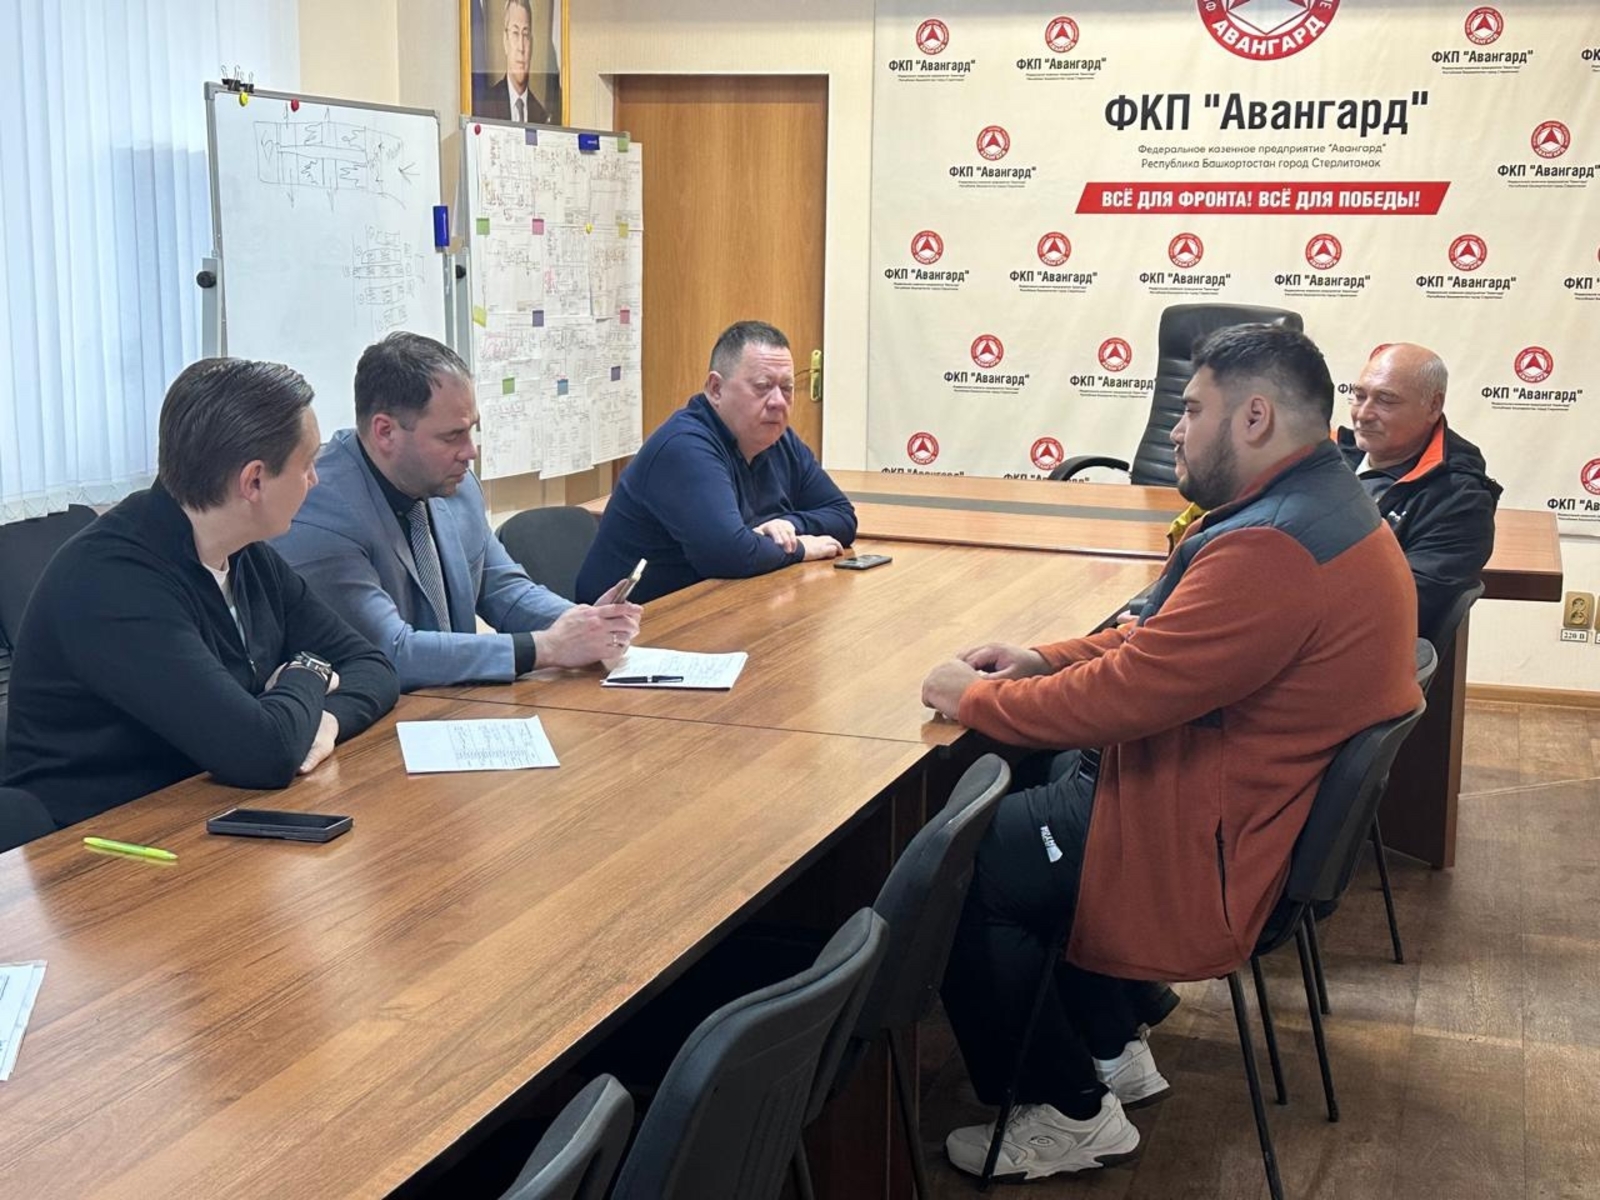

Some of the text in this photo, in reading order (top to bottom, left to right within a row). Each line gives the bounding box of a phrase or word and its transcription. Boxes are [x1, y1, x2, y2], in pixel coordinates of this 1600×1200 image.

[1201, 16, 1326, 55] АВАНГАРД
[1016, 57, 1106, 71] ФКП "Авангард"
[1431, 50, 1533, 65] ФКП "Авангард"
[889, 60, 975, 73] ФКП "Авангард"
[1105, 91, 1429, 137] ФКП "Авангард"
[1138, 145, 1206, 155] Федеральное
[1258, 145, 1326, 155] предприятие
[1141, 157, 1381, 170] Республика Башкортостан город Стерлитамак
[1497, 164, 1526, 177] ФКП
[949, 166, 1036, 180] ФКП "Авангард"
[1102, 188, 1420, 210] ВСЁ ДЛЯ ФРОНТА! ВСЁ ДЛЯ ПОБЕДЫ!
[884, 268, 969, 282] ФКП "Авангард"
[1010, 270, 1098, 285] ФКП "Авангард"
[1139, 272, 1231, 287] ФКП "Авангард"
[1274, 274, 1370, 289] ФКП "Авангард"
[1416, 276, 1517, 290] ФКП "Авангард"
[1564, 277, 1593, 289] ФКП
[944, 371, 1030, 386] ФКП "Авангард"
[1070, 375, 1095, 386] ФКП
[1481, 387, 1583, 404] ФКП "Авангард"
[1547, 498, 1576, 510] ФКП
